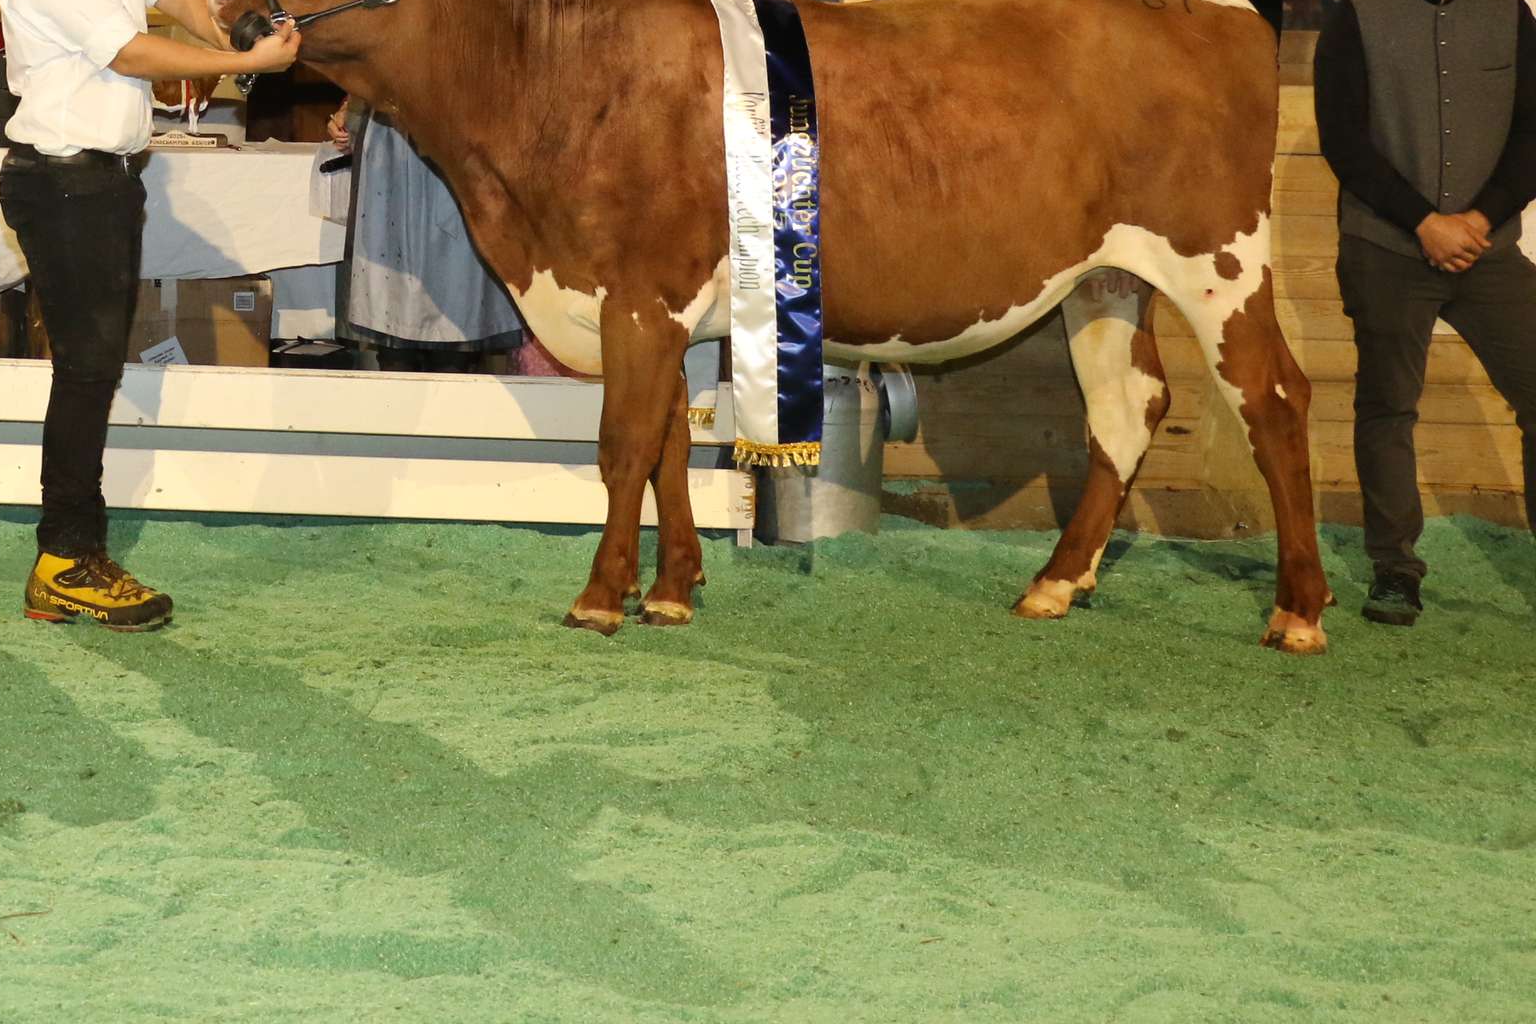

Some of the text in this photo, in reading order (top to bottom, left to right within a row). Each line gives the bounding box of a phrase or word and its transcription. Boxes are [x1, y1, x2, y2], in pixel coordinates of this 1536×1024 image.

[785, 242, 817, 289] Cup
[34, 587, 109, 621] LA SPORTIVA
